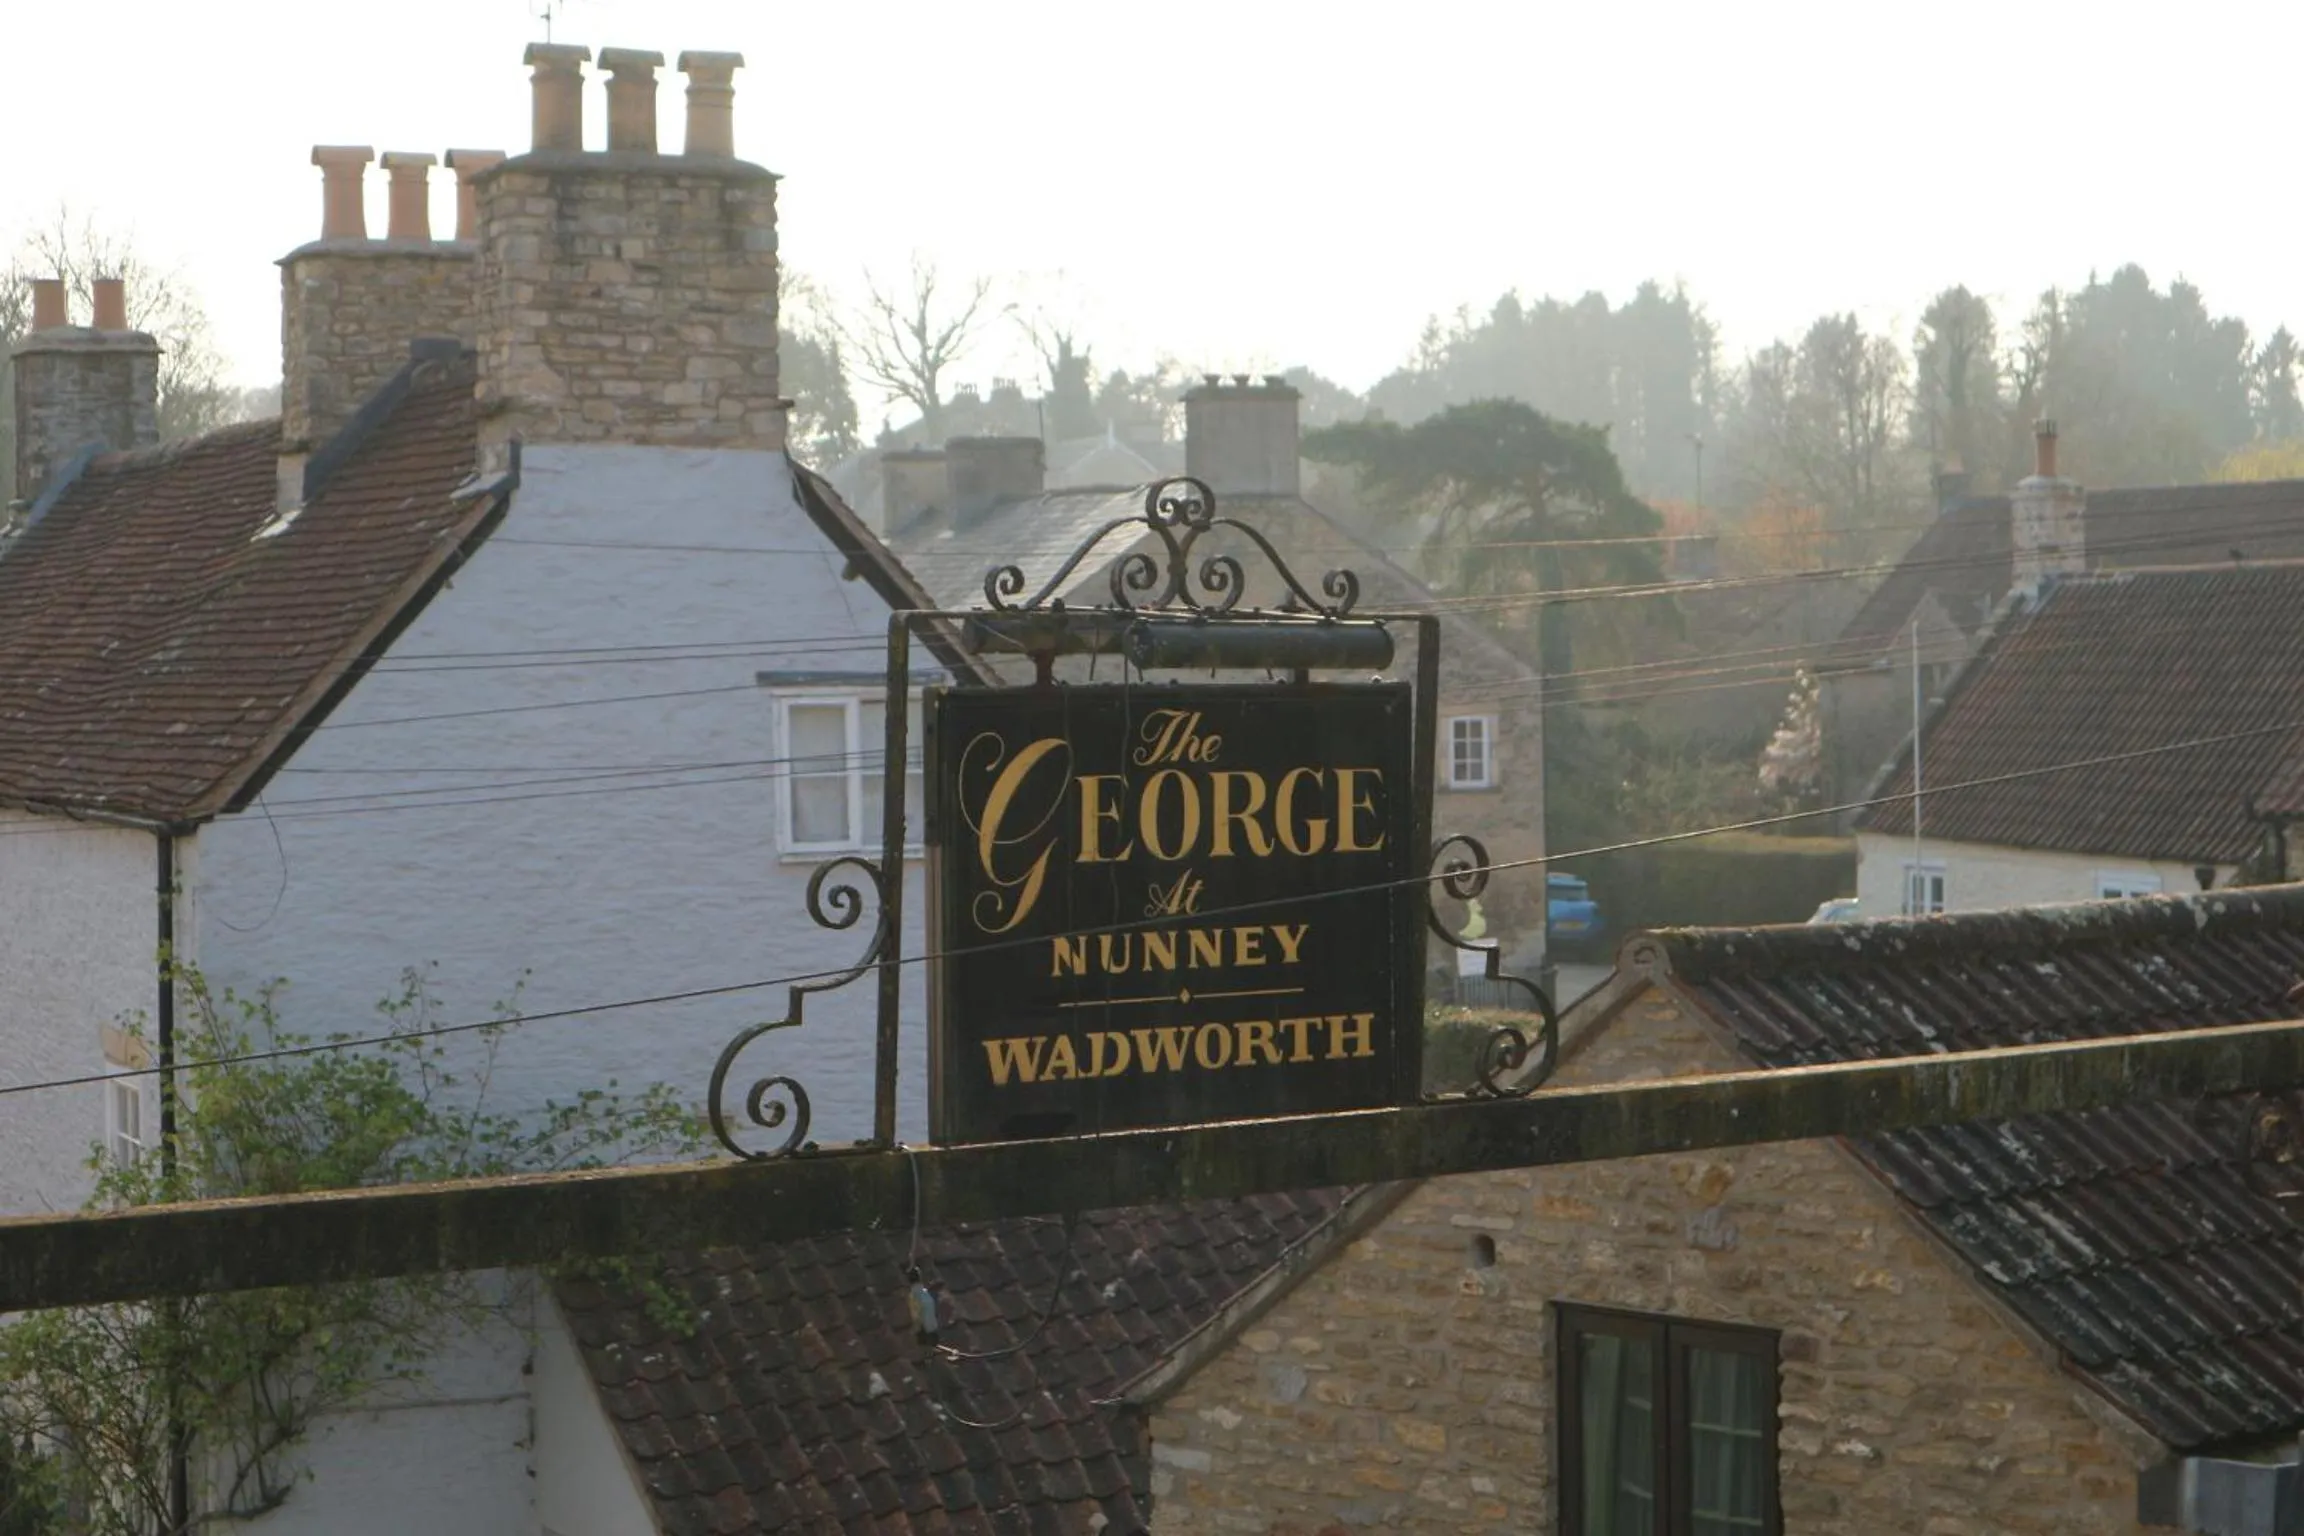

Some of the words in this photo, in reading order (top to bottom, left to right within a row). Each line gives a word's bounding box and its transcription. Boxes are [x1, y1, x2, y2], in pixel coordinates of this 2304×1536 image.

[1133, 709, 1222, 766] The
[959, 732, 1386, 933] GEORGE
[1144, 868, 1205, 917] At
[1051, 924, 1309, 977] NUNNEY
[982, 1013, 1375, 1085] WADWORTH
